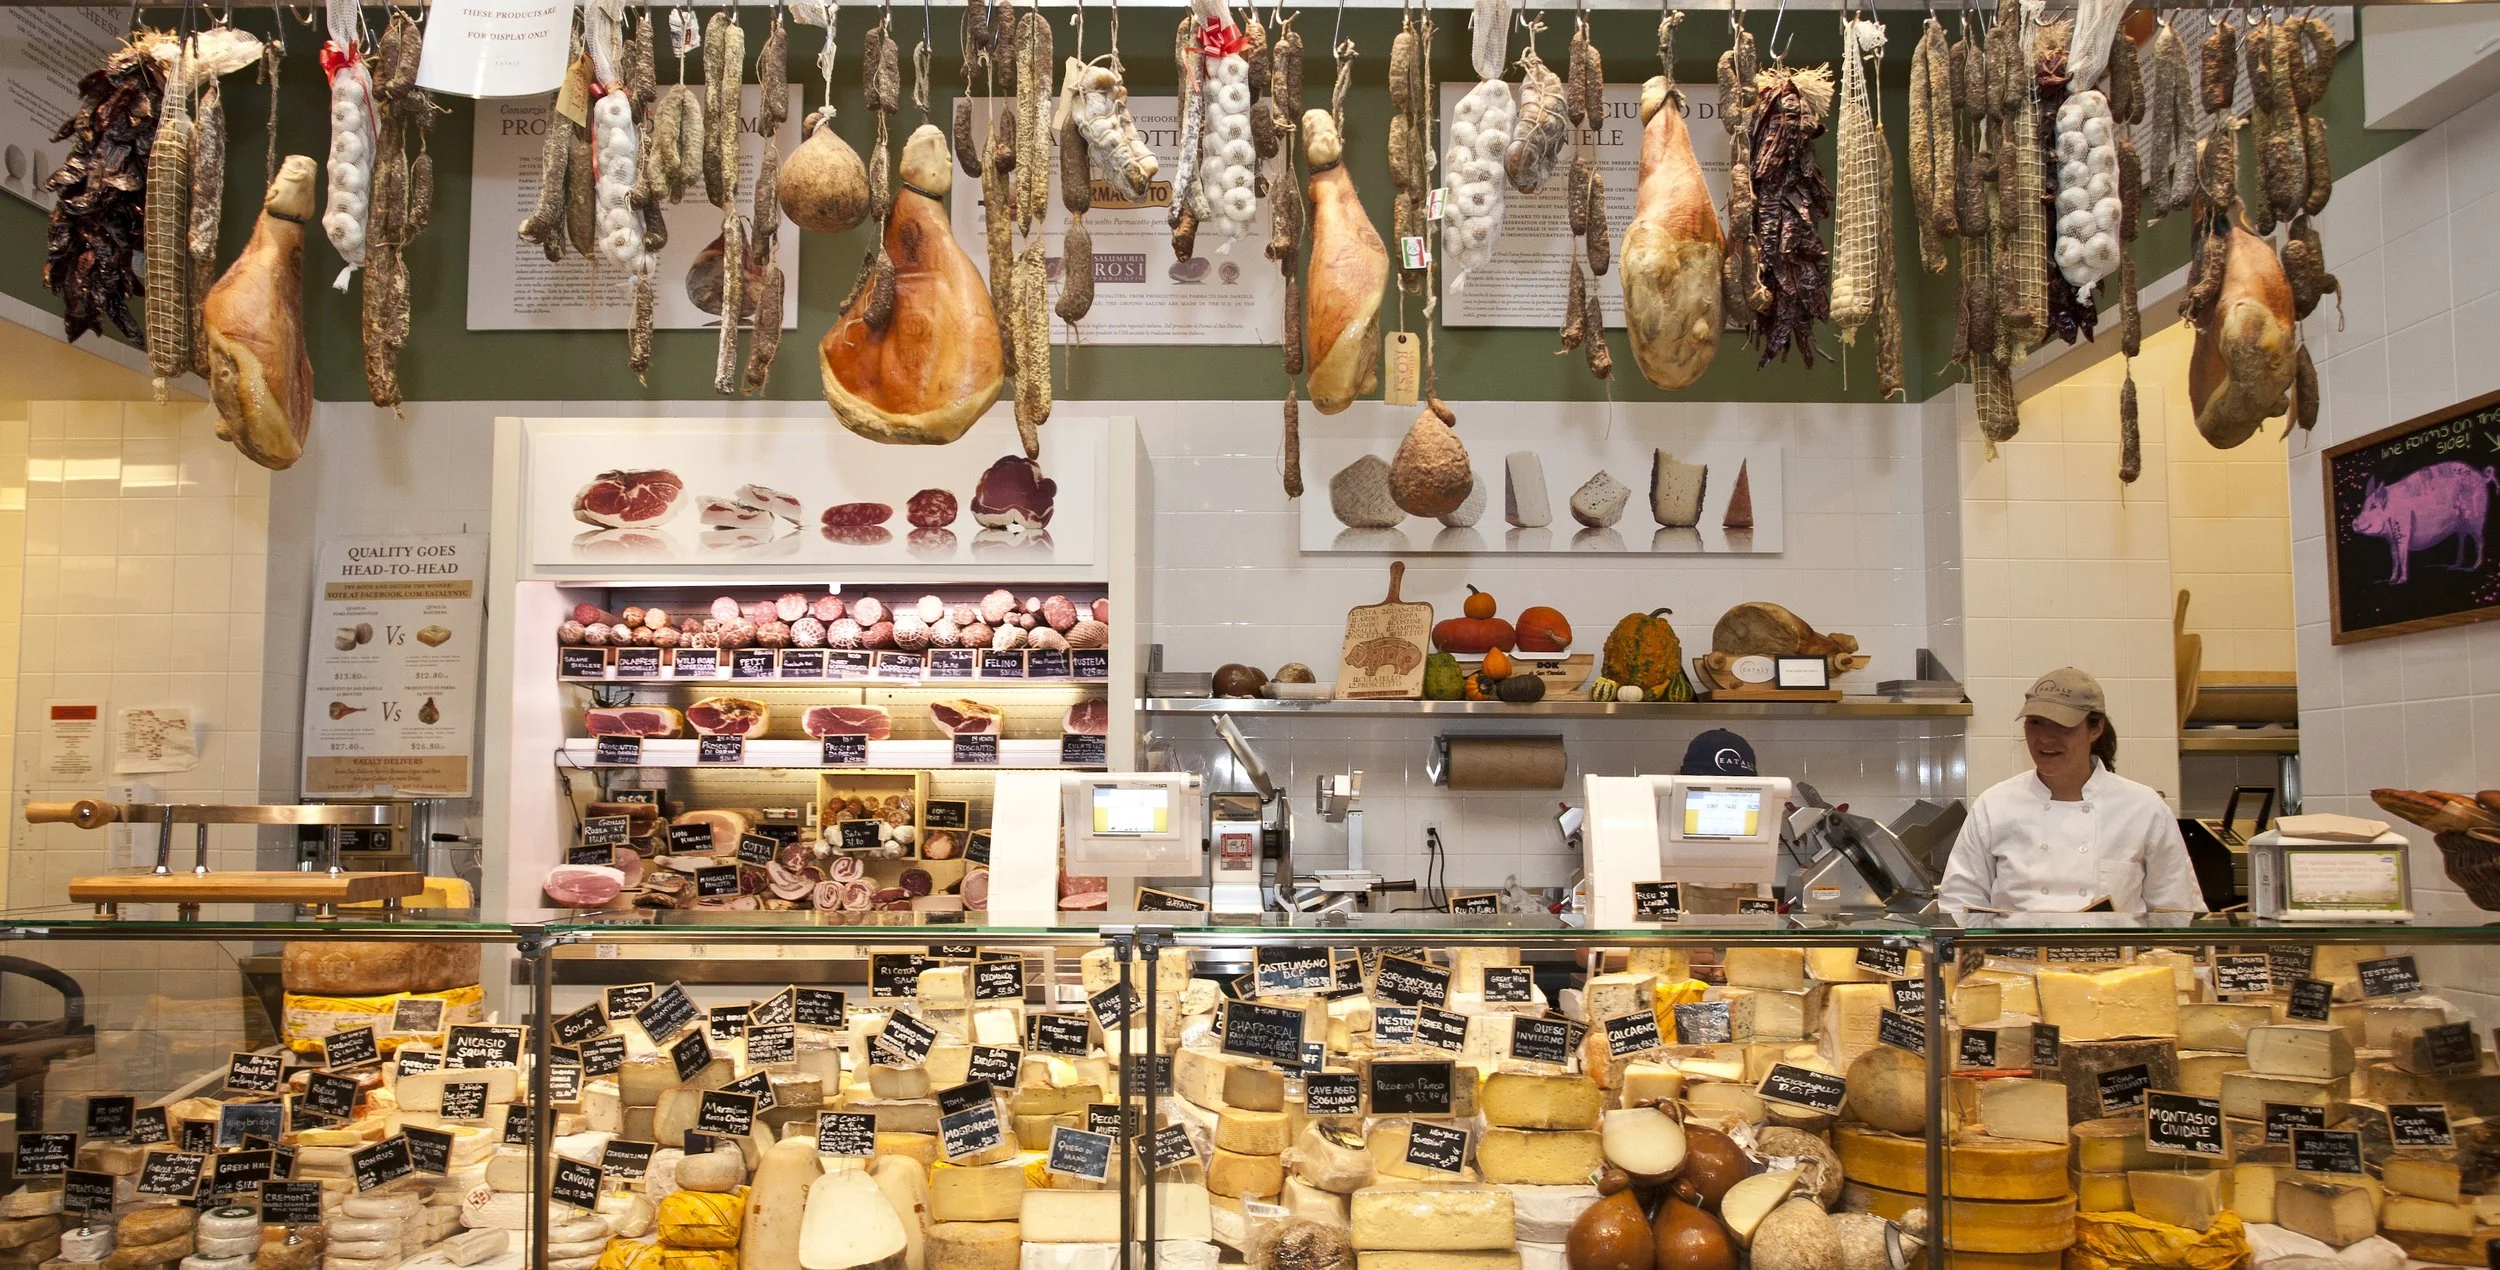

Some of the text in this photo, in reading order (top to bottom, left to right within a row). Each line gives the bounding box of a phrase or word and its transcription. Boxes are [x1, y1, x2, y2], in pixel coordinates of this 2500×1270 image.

[463, 7, 557, 19] THESE PRODUCTS ARE
[468, 30, 549, 41] FOR DISPLAY ONLY
[500, 104, 546, 116] Consorzio
[1136, 115, 1179, 123] CHOOSE
[1093, 255, 1145, 263] SALUMERIA
[1094, 263, 1145, 277] ROSI
[2436, 432, 2471, 455] side!
[348, 545, 457, 562] QUALITY GOES
[341, 563, 459, 576] HEAD-TO-HEAD
[327, 591, 348, 599] VOTE
[349, 591, 358, 599] AT
[385, 625, 406, 646] Vs
[676, 657, 697, 665] WILD
[896, 655, 921, 665] SPICY
[985, 658, 1018, 668] FELINO
[1536, 661, 1560, 670] DOK
[415, 672, 444, 680] $12.80
[1742, 666, 1771, 675] EATALY
[2039, 686, 2073, 695] EATALY
[382, 701, 402, 722] Vs
[410, 742, 440, 750] $26.80
[741, 840, 772, 856] COPPA
[1257, 958, 1328, 975] CASTELMAGNO
[2361, 967, 2400, 978] TESTUN
[1379, 968, 1444, 992] GORGONZOLA
[1490, 975, 1528, 984] GREAT HILL
[2364, 972, 2414, 986] DI CAPRA
[1377, 979, 1445, 1000] 300 DAYS AGED
[564, 1018, 593, 1037] SOLA
[1229, 1020, 1298, 1040] CHAPARRAL
[1419, 1018, 1465, 1036] ASHER BLUE
[1533, 1022, 1567, 1037] QUESO
[1607, 1022, 1656, 1042] CALCAGNO
[456, 1036, 507, 1049] NICASIO
[1516, 1031, 1565, 1046] INVIERNO
[456, 1048, 504, 1060] SQUARE
[1307, 1085, 1357, 1095] CAVE AGED
[1770, 1074, 1841, 1095] CACIOCAVALLO
[943, 1096, 966, 1107] TOMA
[1311, 1095, 1357, 1105] SOGLIANO
[2149, 1107, 2219, 1126] MONTASIO
[2277, 1112, 2307, 1123] TOMA
[2393, 1116, 2428, 1127] Green
[2160, 1122, 2212, 1139] CIVIDALE
[2405, 1125, 2436, 1137] Fields
[357, 1150, 395, 1169] BONRUS
[219, 1161, 271, 1174] GREEN HILL
[561, 1169, 595, 1189] CAVOUR
[264, 1193, 311, 1202] CREMONT
